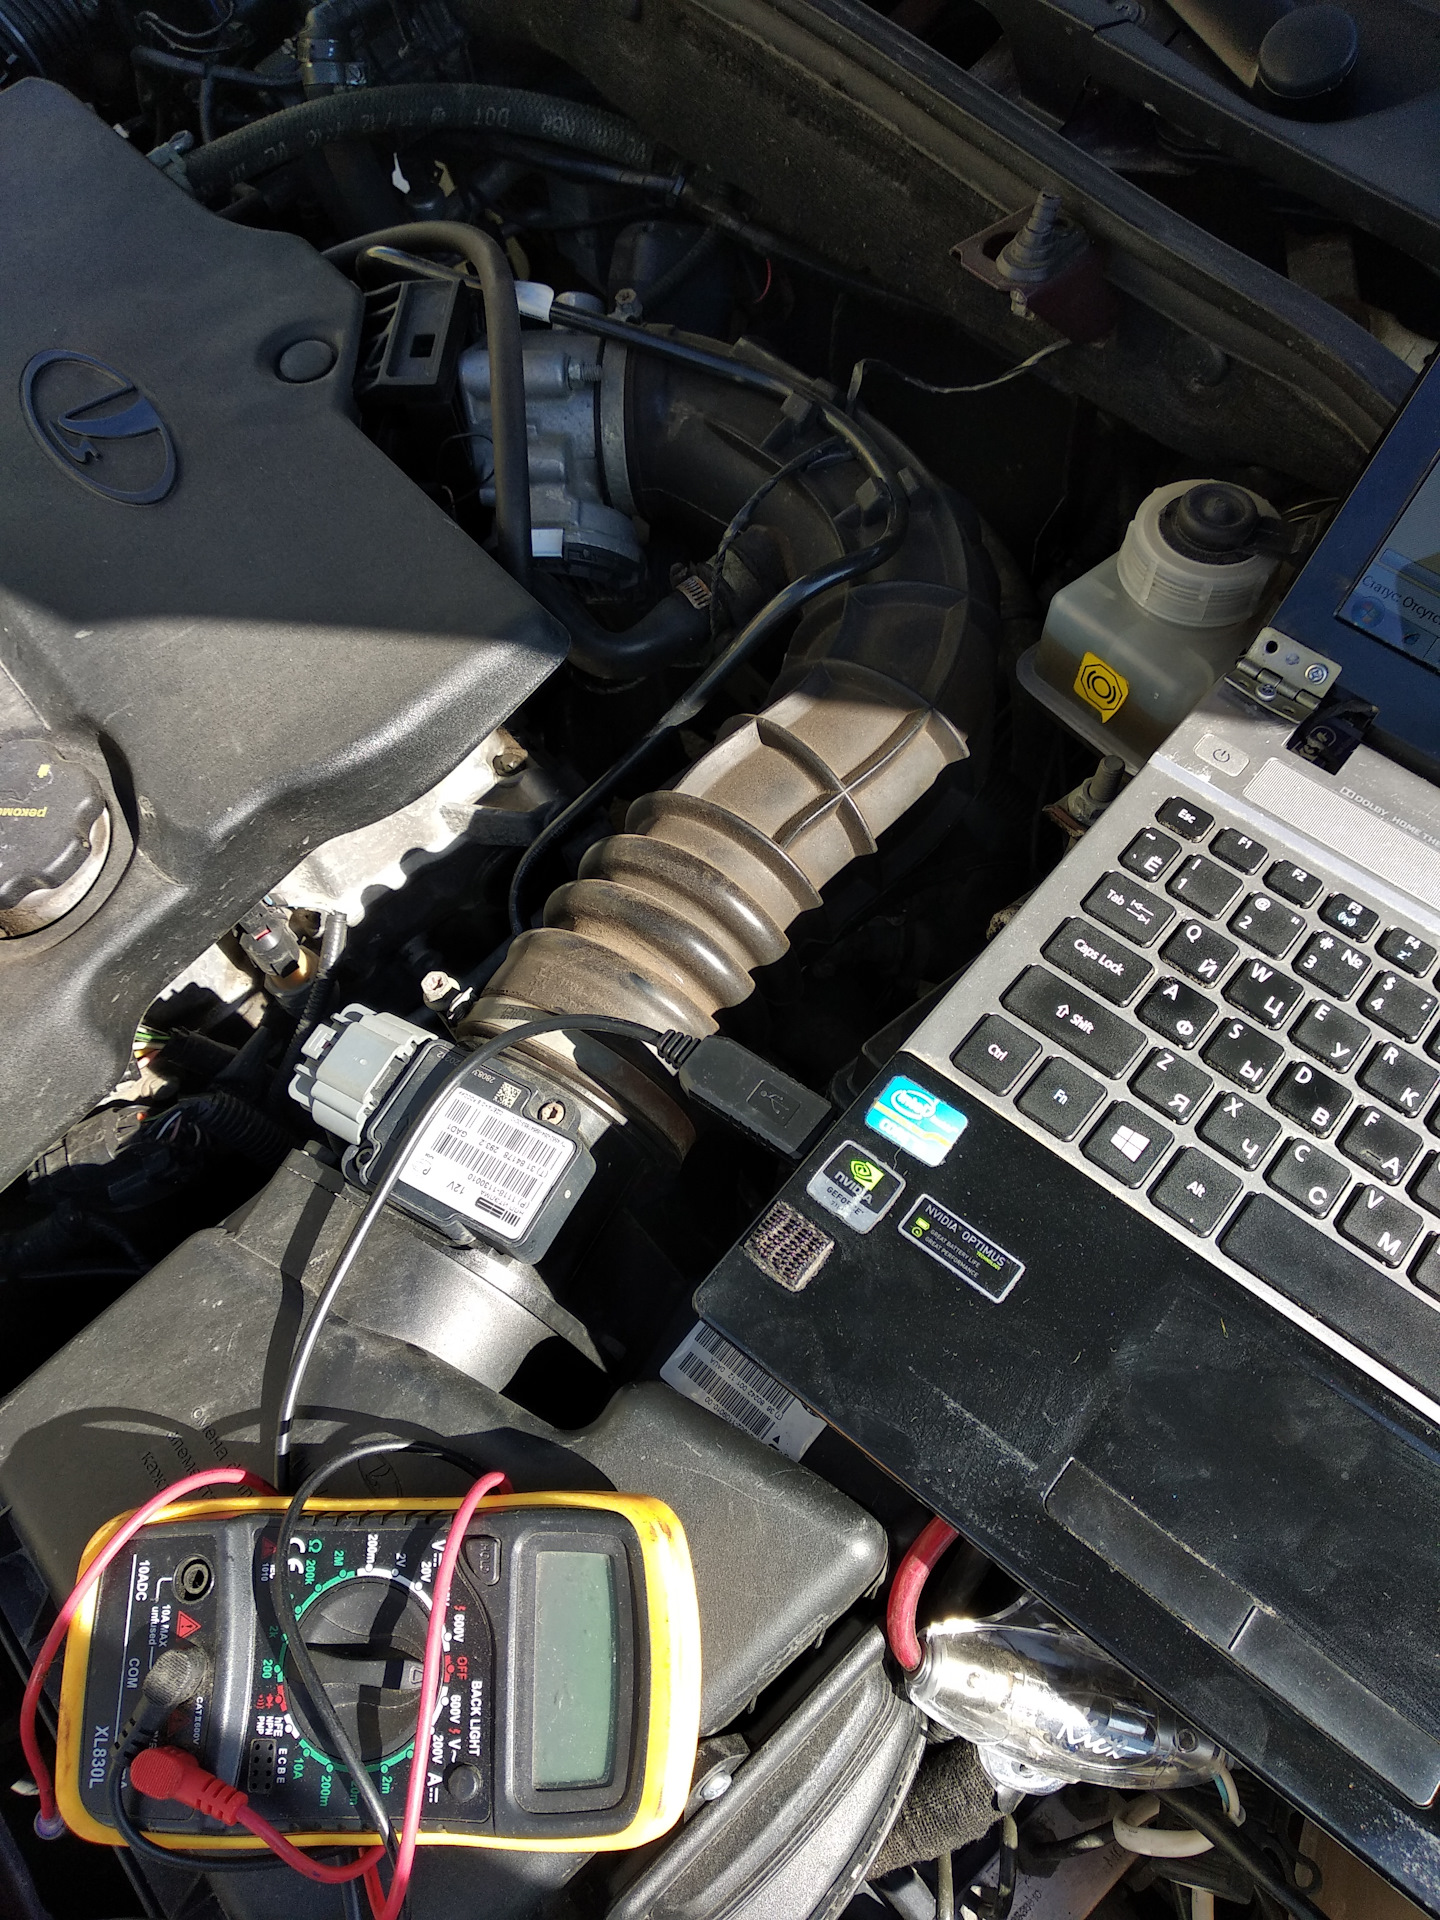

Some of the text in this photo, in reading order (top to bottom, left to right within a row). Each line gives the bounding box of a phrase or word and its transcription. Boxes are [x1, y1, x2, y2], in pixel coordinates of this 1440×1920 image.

[1402, 596, 1440, 625] Отсутс
[1176, 807, 1197, 825] Esc
[1353, 794, 1388, 817] DOLBY
[1390, 815, 1422, 836] HOME
[1236, 834, 1253, 851] F1
[1290, 866, 1308, 883] F2
[1104, 887, 1127, 907] Tab
[1346, 899, 1364, 917] F3
[1181, 921, 1205, 945] Q
[1237, 913, 1254, 931] 2
[1403, 934, 1422, 951] F4
[1070, 936, 1126, 977] Caps Lock
[1196, 955, 1220, 979] Й
[1301, 953, 1318, 971] 3
[1247, 961, 1274, 986] W
[1161, 980, 1182, 1002] A
[1368, 994, 1386, 1012] 4
[1260, 994, 1285, 1020] Ц
[1312, 1002, 1331, 1022] E
[1067, 1011, 1096, 1036] Shift
[1172, 1015, 1197, 1039] Ф
[1226, 1021, 1245, 1042] S
[984, 1041, 1009, 1063] Ctrl
[1155, 1051, 1175, 1072] Z
[1380, 1045, 1401, 1067] R
[1237, 1058, 1264, 1084] Ы
[1292, 1064, 1315, 1088] D
[1051, 1087, 1071, 1106] Fn
[1166, 1089, 1191, 1114] Я
[1221, 1095, 1245, 1119] X
[1362, 1109, 1381, 1130] F
[445, 1178, 467, 1195] 12V
[1184, 1176, 1208, 1199] Alt
[1361, 1188, 1385, 1213] V
[924, 1203, 1007, 1267] NVIDIA OPTIMUS
[923, 1235, 979, 1278] GREAT PERFORMANCE
[929, 1228, 981, 1268] GREAT BATTERY LIFE
[332, 1548, 345, 1567] 2M
[364, 1532, 379, 1565] 200m
[394, 1551, 406, 1567] 2V
[134, 1558, 151, 1602] 10ADC
[303, 1558, 317, 1585] 200k
[419, 1560, 432, 1582] 20V
[146, 1605, 160, 1646] unfused
[267, 1624, 278, 1639] 2k
[452, 1613, 465, 1644] 600V
[125, 1657, 140, 1689] COM
[260, 1658, 274, 1679] 200
[456, 1655, 467, 1680] OFF
[449, 1693, 461, 1724] 600V
[467, 1679, 483, 1757] BACK LIGHT
[254, 1714, 265, 1735] PNP
[263, 1715, 274, 1736] NPN
[272, 1716, 284, 1737] hFE
[87, 1723, 110, 1791] XL830L
[431, 1734, 443, 1764] 200V
[291, 1756, 304, 1780] 10A
[317, 1773, 332, 1807] 200m
[379, 1774, 393, 1794] 2m
